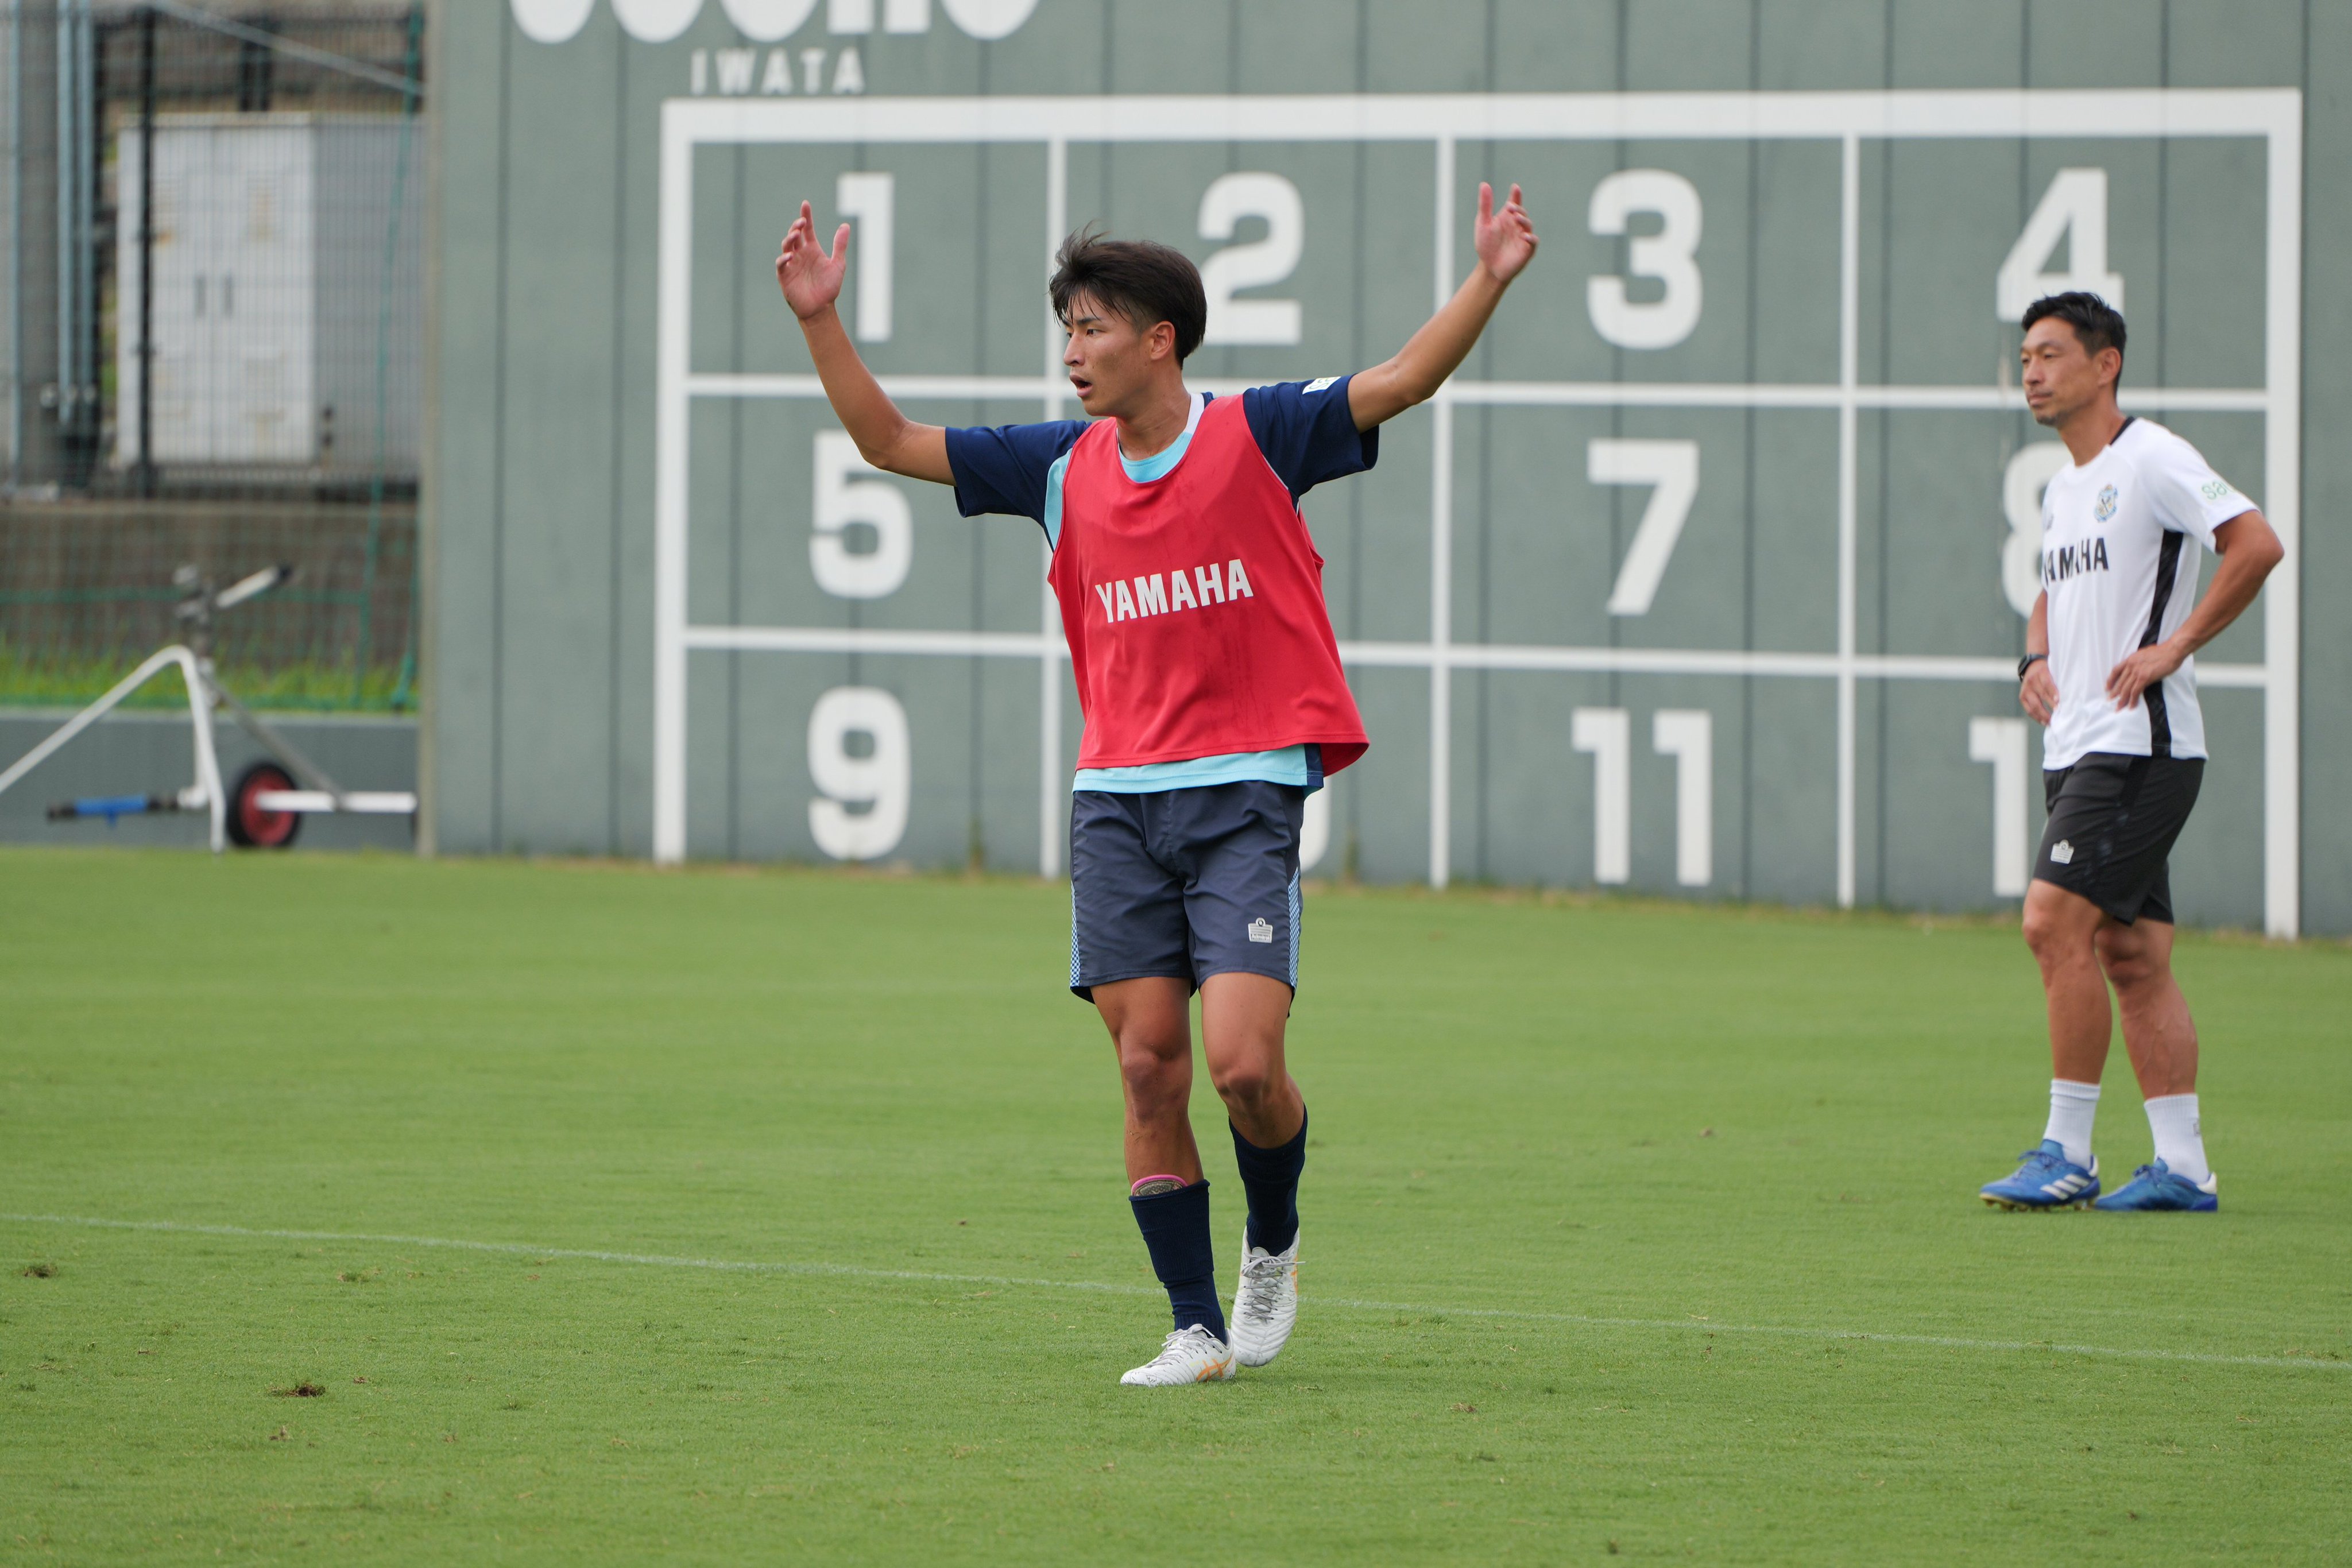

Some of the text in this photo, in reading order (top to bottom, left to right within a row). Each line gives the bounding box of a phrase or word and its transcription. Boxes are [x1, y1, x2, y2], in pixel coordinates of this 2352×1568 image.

[690, 48, 865, 94] IWATA
[837, 173, 894, 342] 1
[1198, 172, 1303, 345] 2
[1587, 169, 1703, 349] 3
[1997, 168, 2124, 322] 4
[810, 430, 912, 599] 5
[1094, 558, 1254, 624] YAMAHA
[1587, 439, 1700, 615] 7
[807, 687, 911, 858] 9
[1570, 708, 1713, 885] 11
